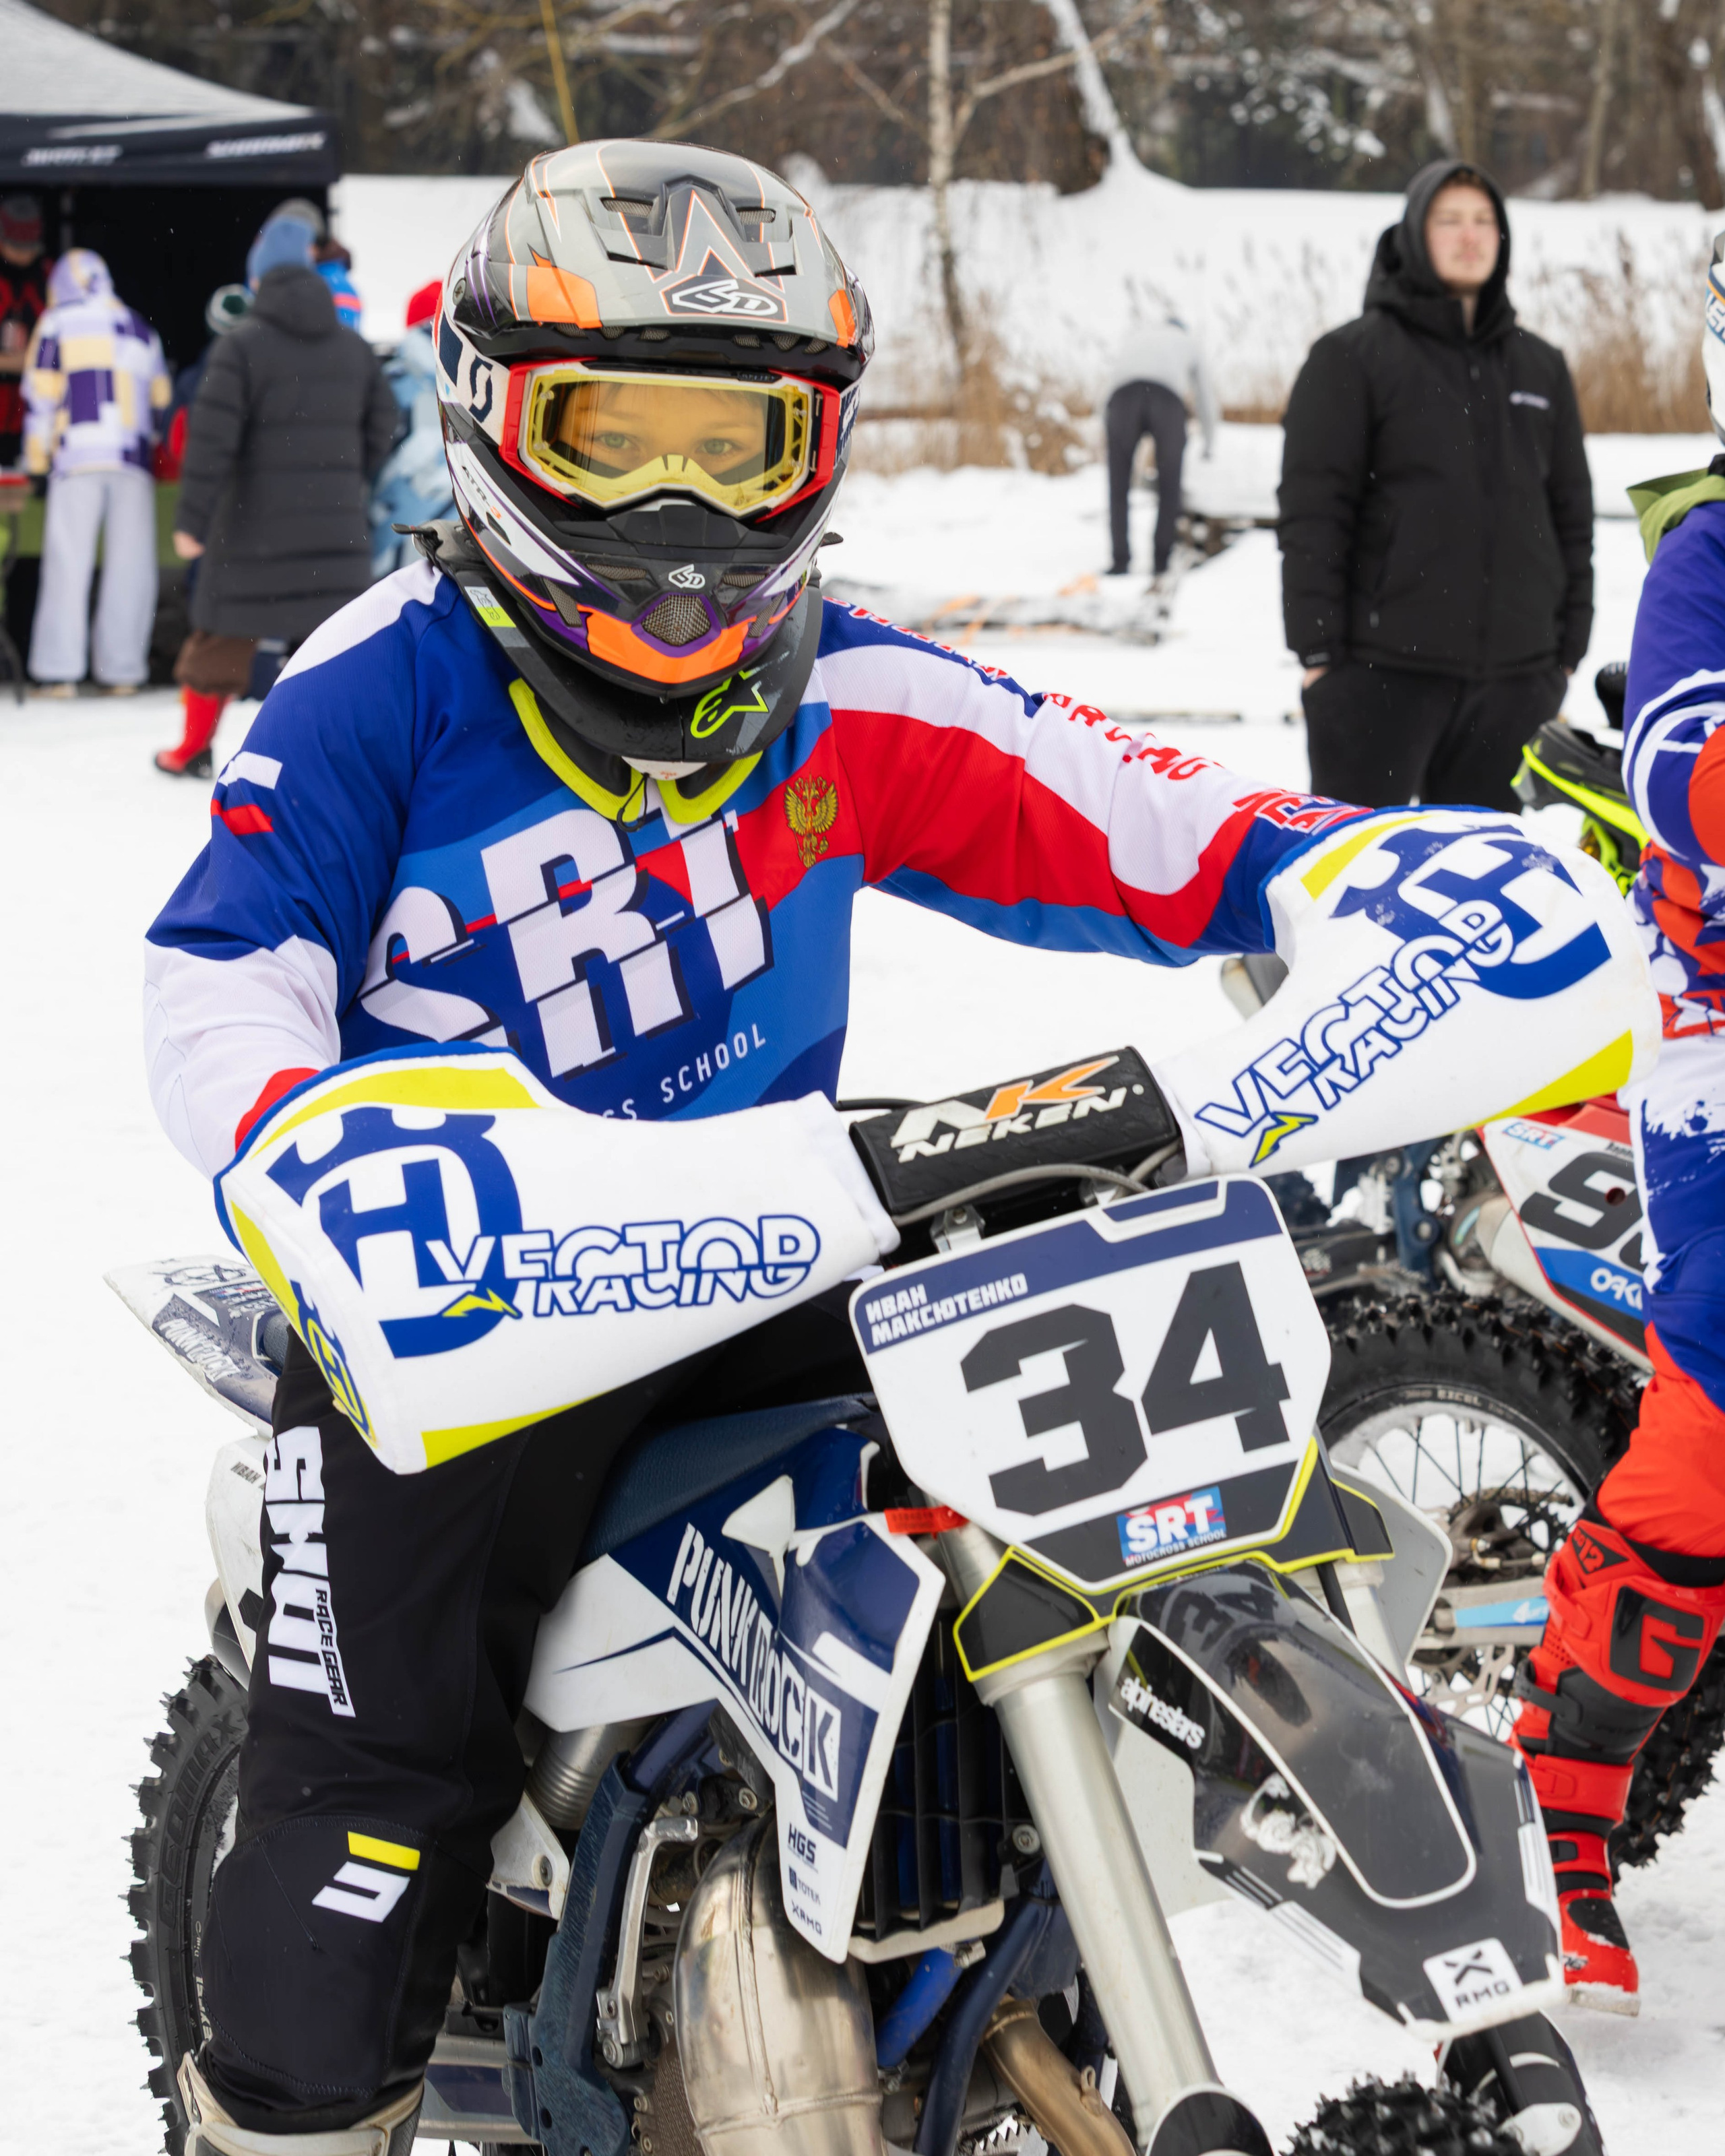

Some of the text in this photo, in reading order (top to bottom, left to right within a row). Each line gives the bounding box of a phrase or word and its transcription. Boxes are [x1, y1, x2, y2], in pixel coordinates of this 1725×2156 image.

[660, 1023, 767, 1104] SCHOOL
[898, 1086, 1128, 1164] NEKEN
[865, 1283, 928, 1325] ИВАН
[871, 1272, 1029, 1347] МАКСЮТЕНКО
[960, 1260, 1292, 1517] 34
[1124, 1527, 1228, 1568] MOTOCROSS SCHOOL
[1125, 1493, 1215, 1554] SRT
[315, 1588, 349, 1707] RACE GEAR
[666, 1521, 842, 1803] PUNK ROCK
[1120, 1677, 1205, 1749] alpinestars
[788, 1821, 817, 1865] HGS
